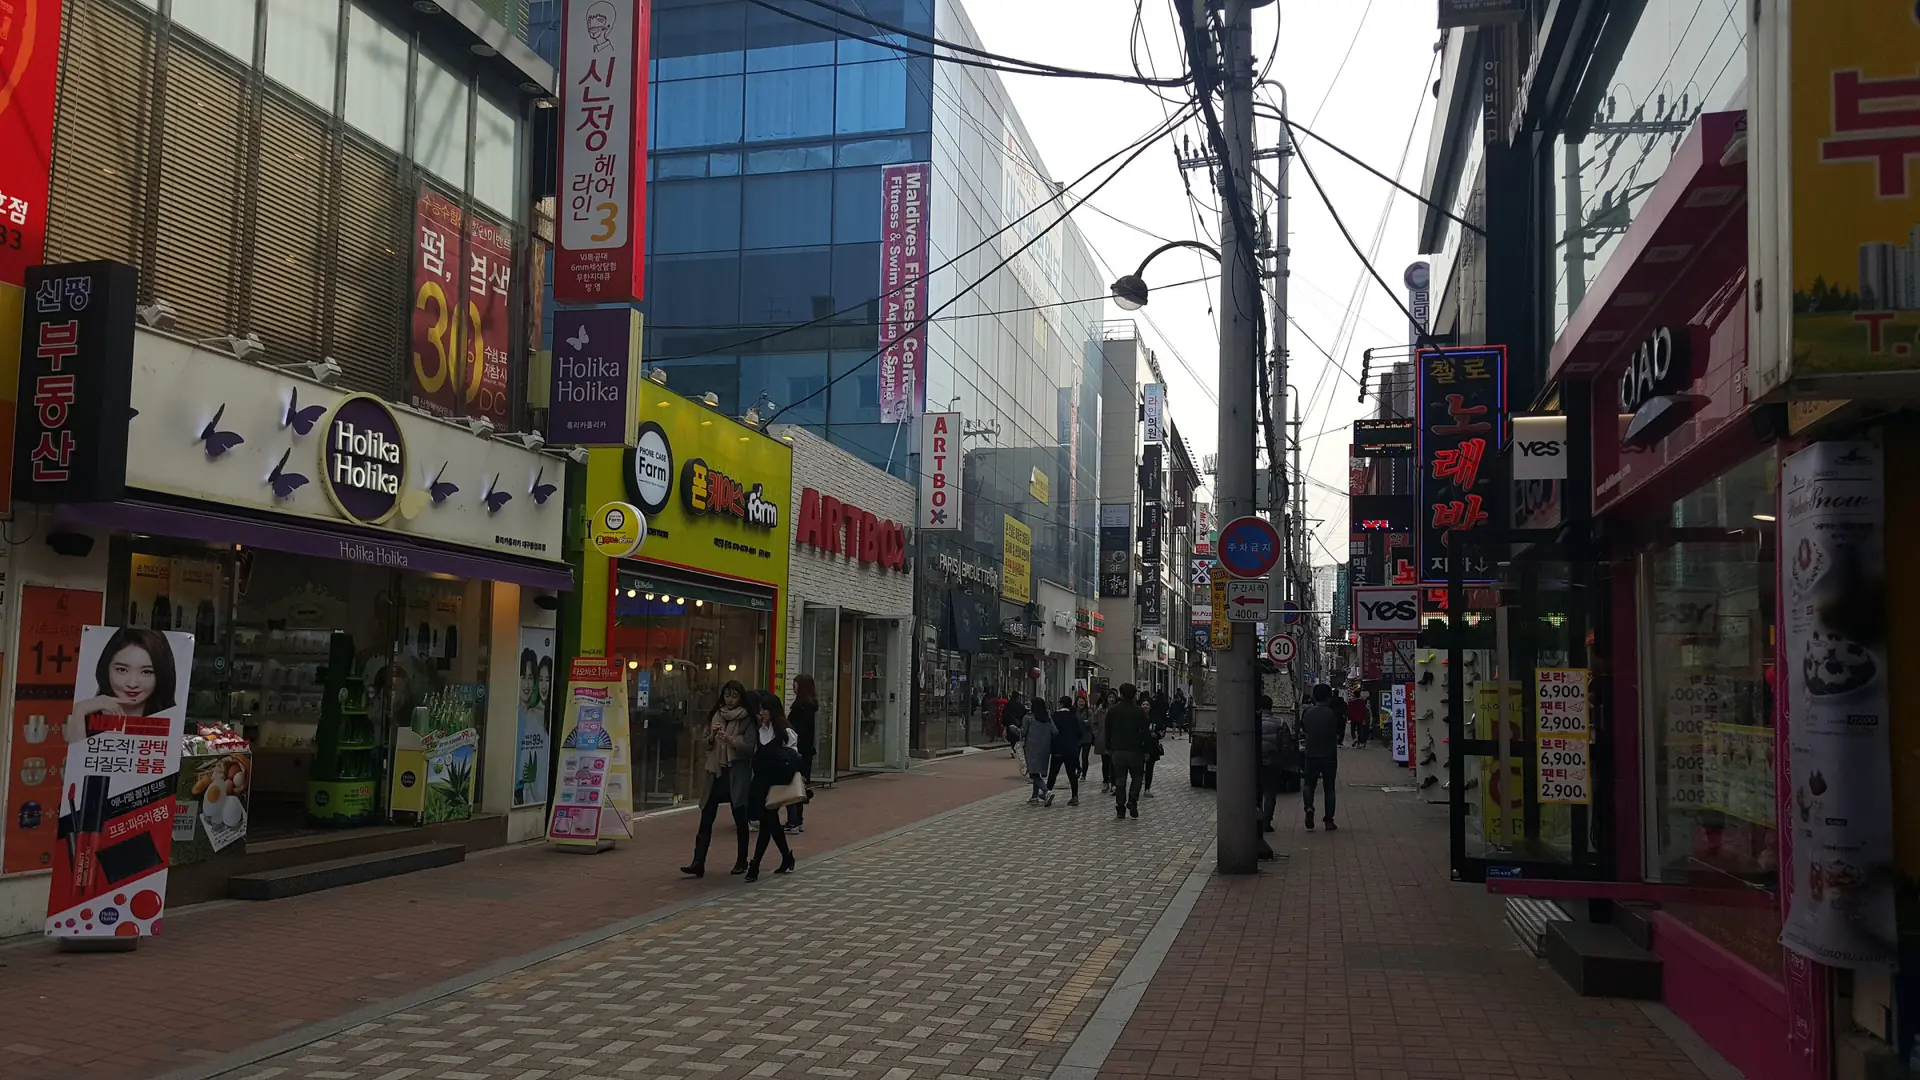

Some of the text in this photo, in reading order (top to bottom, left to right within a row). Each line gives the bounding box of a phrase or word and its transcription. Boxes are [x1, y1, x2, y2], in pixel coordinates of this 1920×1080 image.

[576, 57, 616, 151] 신정
[890, 176, 902, 229] Fitness
[590, 202, 619, 242] 3
[905, 172, 921, 257] Maldives
[889, 233, 901, 242] &
[888, 245, 901, 286] Swim
[36, 276, 92, 313] 신평
[903, 262, 919, 331] Fitness
[558, 357, 620, 378] Holika
[885, 355, 899, 401] Sauna
[31, 320, 79, 483] 부동산
[557, 380, 619, 402] Holika
[334, 420, 400, 464] Holika
[639, 446, 667, 463] PHONE CASE
[333, 453, 399, 495] Holika
[638, 457, 667, 482] Farm
[930, 416, 948, 525] ARTBOX
[1430, 393, 1492, 548] 노래방
[796, 487, 915, 575] ARTBOX
[340, 541, 409, 567] Holika Holika
[1227, 542, 1272, 553] 주차금지
[939, 553, 959, 575] PARIS
[1110, 564, 1121, 573] 3F
[1231, 583, 1265, 593] 구간시작
[1274, 642, 1290, 655] 30
[1539, 671, 1566, 683] 브라
[1540, 701, 1566, 715] 팬티
[86, 737, 169, 756] 압도적! 광택
[1540, 738, 1567, 750] 브라
[84, 755, 167, 775] 터질듯! 볼륨
[1541, 769, 1567, 783] 팬티
[152, 805, 170, 823] 증정
